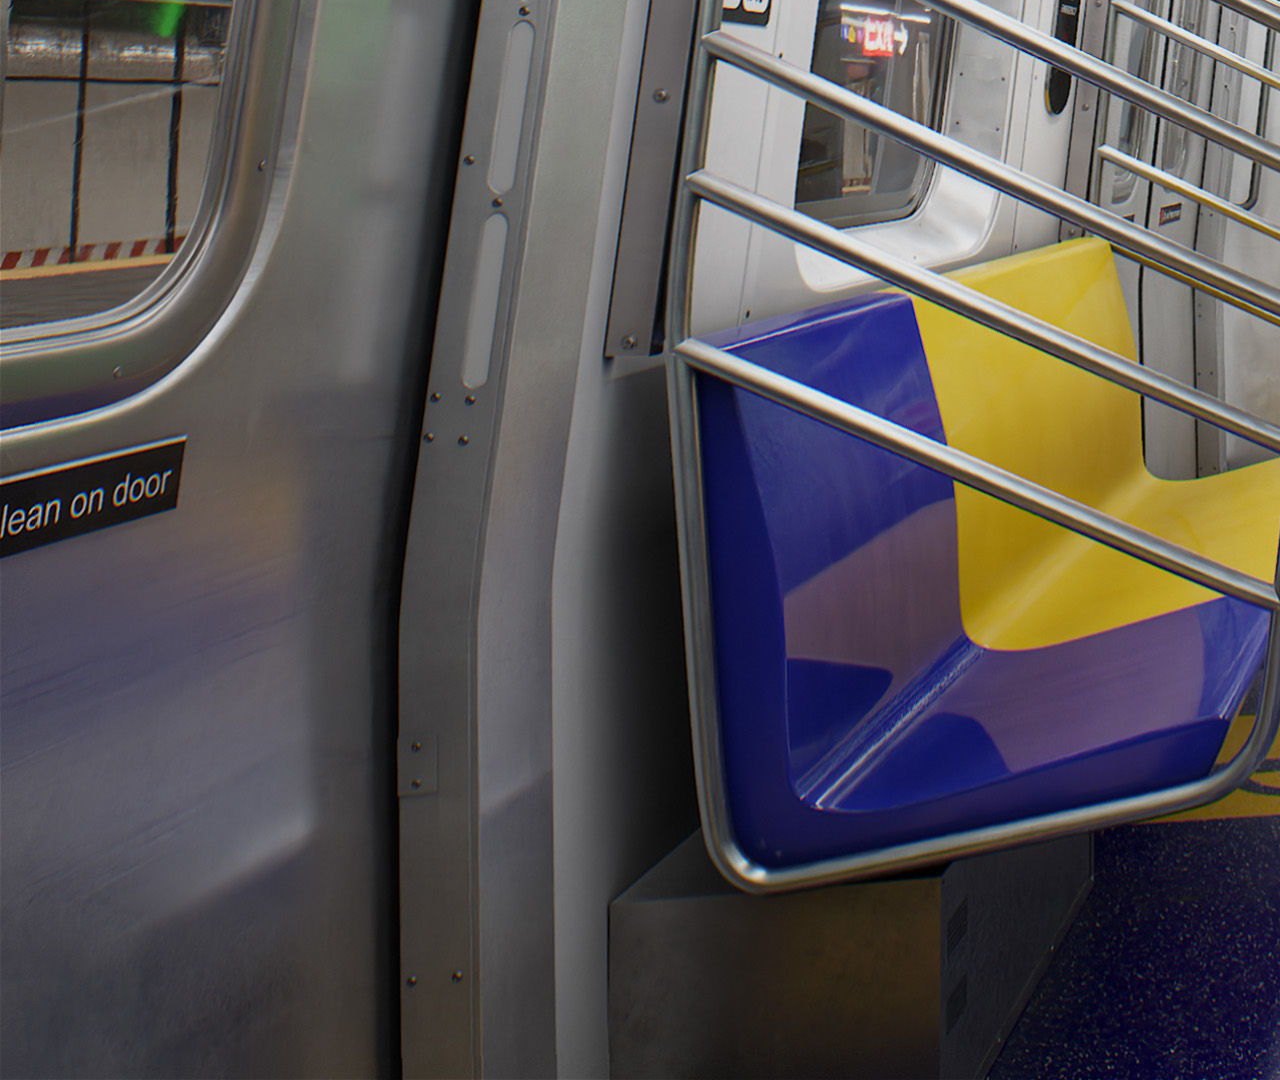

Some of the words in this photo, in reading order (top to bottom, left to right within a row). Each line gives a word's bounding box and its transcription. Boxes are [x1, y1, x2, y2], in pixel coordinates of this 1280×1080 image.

[0, 497, 63, 539] lean
[69, 487, 105, 519] on
[113, 469, 173, 508] door
